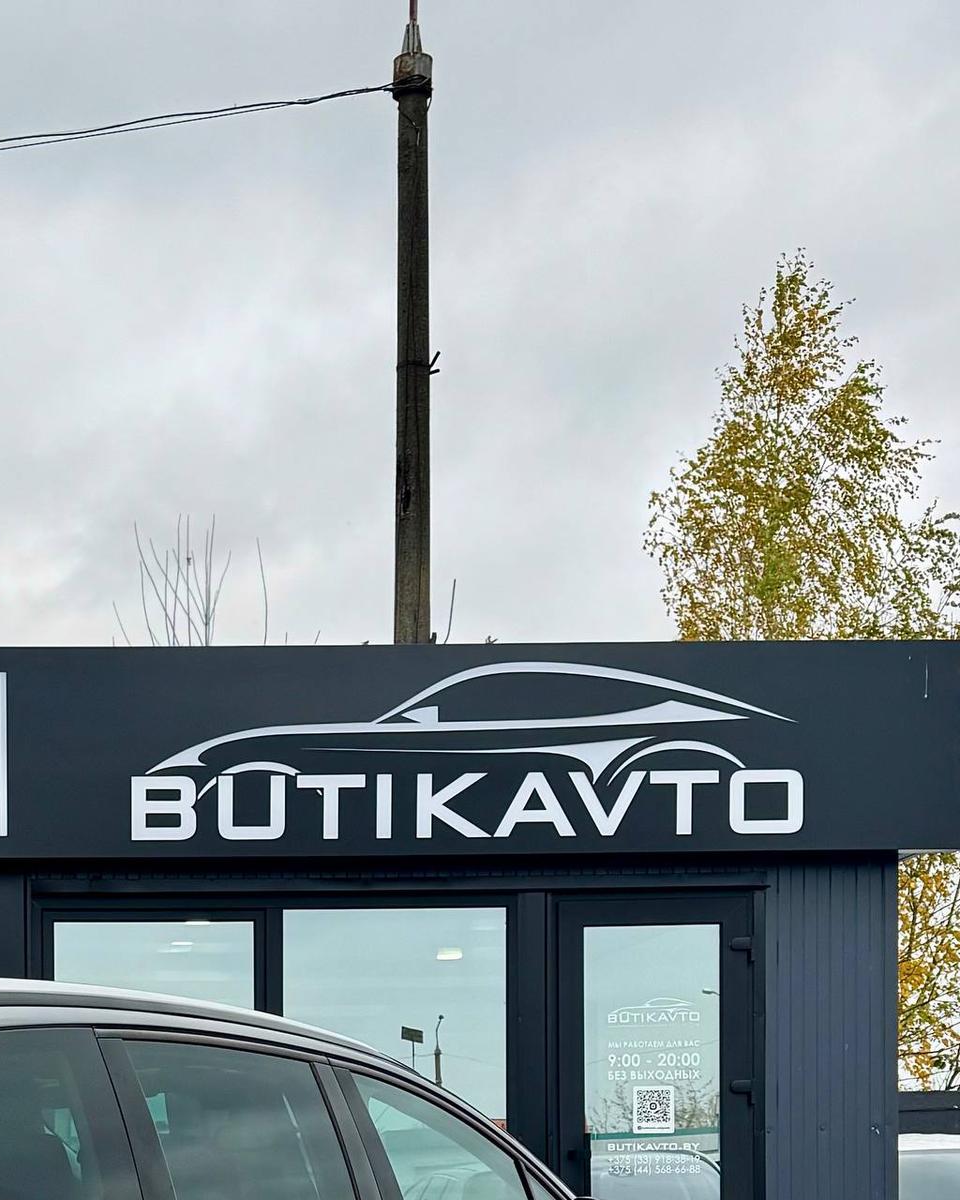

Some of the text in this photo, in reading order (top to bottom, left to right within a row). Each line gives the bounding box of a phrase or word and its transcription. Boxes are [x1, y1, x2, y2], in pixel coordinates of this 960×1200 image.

[130, 768, 805, 841] BUTIKAVTO
[608, 1011, 700, 1023] BUTIKAVTO
[608, 1054, 640, 1067] 9:00
[658, 1053, 700, 1067] 20:00
[608, 1070, 701, 1081] БЕЗ ВЫХОДНЫХ
[607, 1142, 701, 1151] BUTIKAVTO.BY
[634, 1164, 652, 1176] (44)
